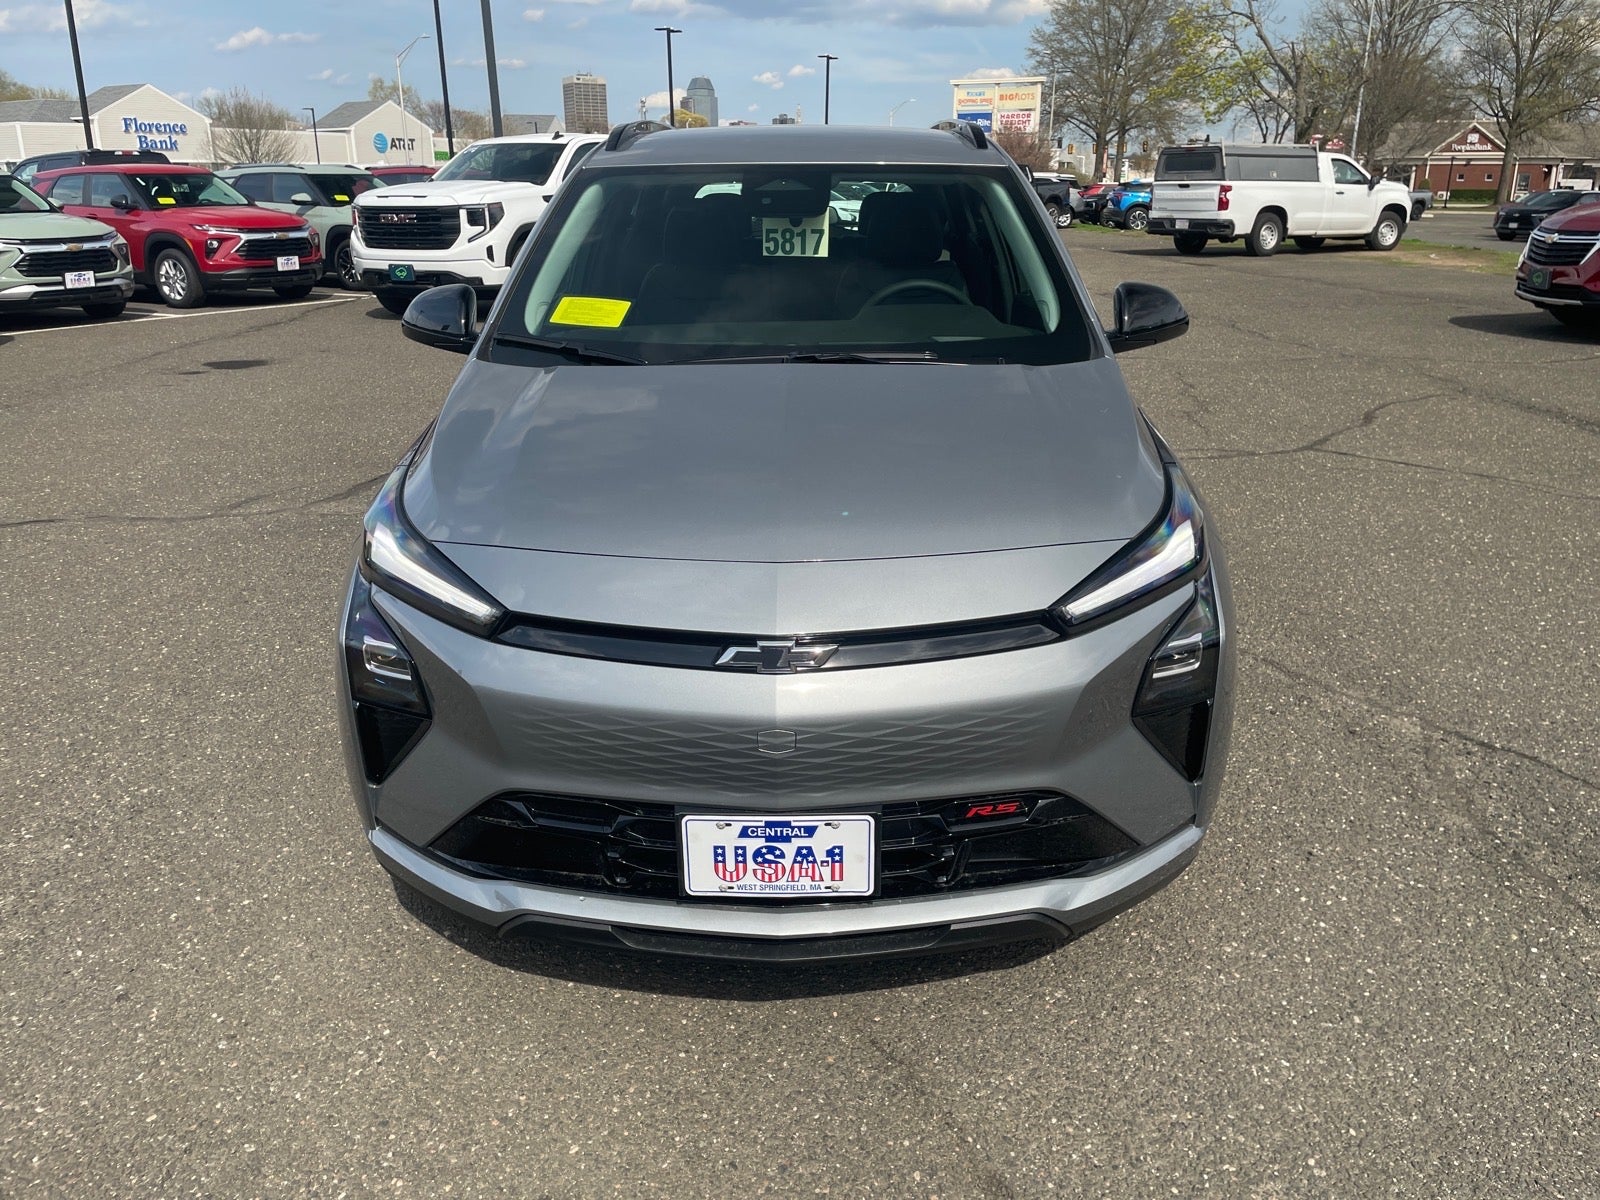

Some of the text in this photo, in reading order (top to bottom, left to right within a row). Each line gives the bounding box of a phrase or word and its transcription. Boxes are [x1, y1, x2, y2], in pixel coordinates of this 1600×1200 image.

[122, 117, 188, 134] Florence
[137, 135, 179, 151] Bank
[764, 228, 825, 255] 5817
[965, 801, 1020, 818] RS
[747, 826, 809, 837] CENTRAL
[712, 844, 844, 883] USA-1
[736, 883, 822, 893] WEST SPRINGFIELD, MA
